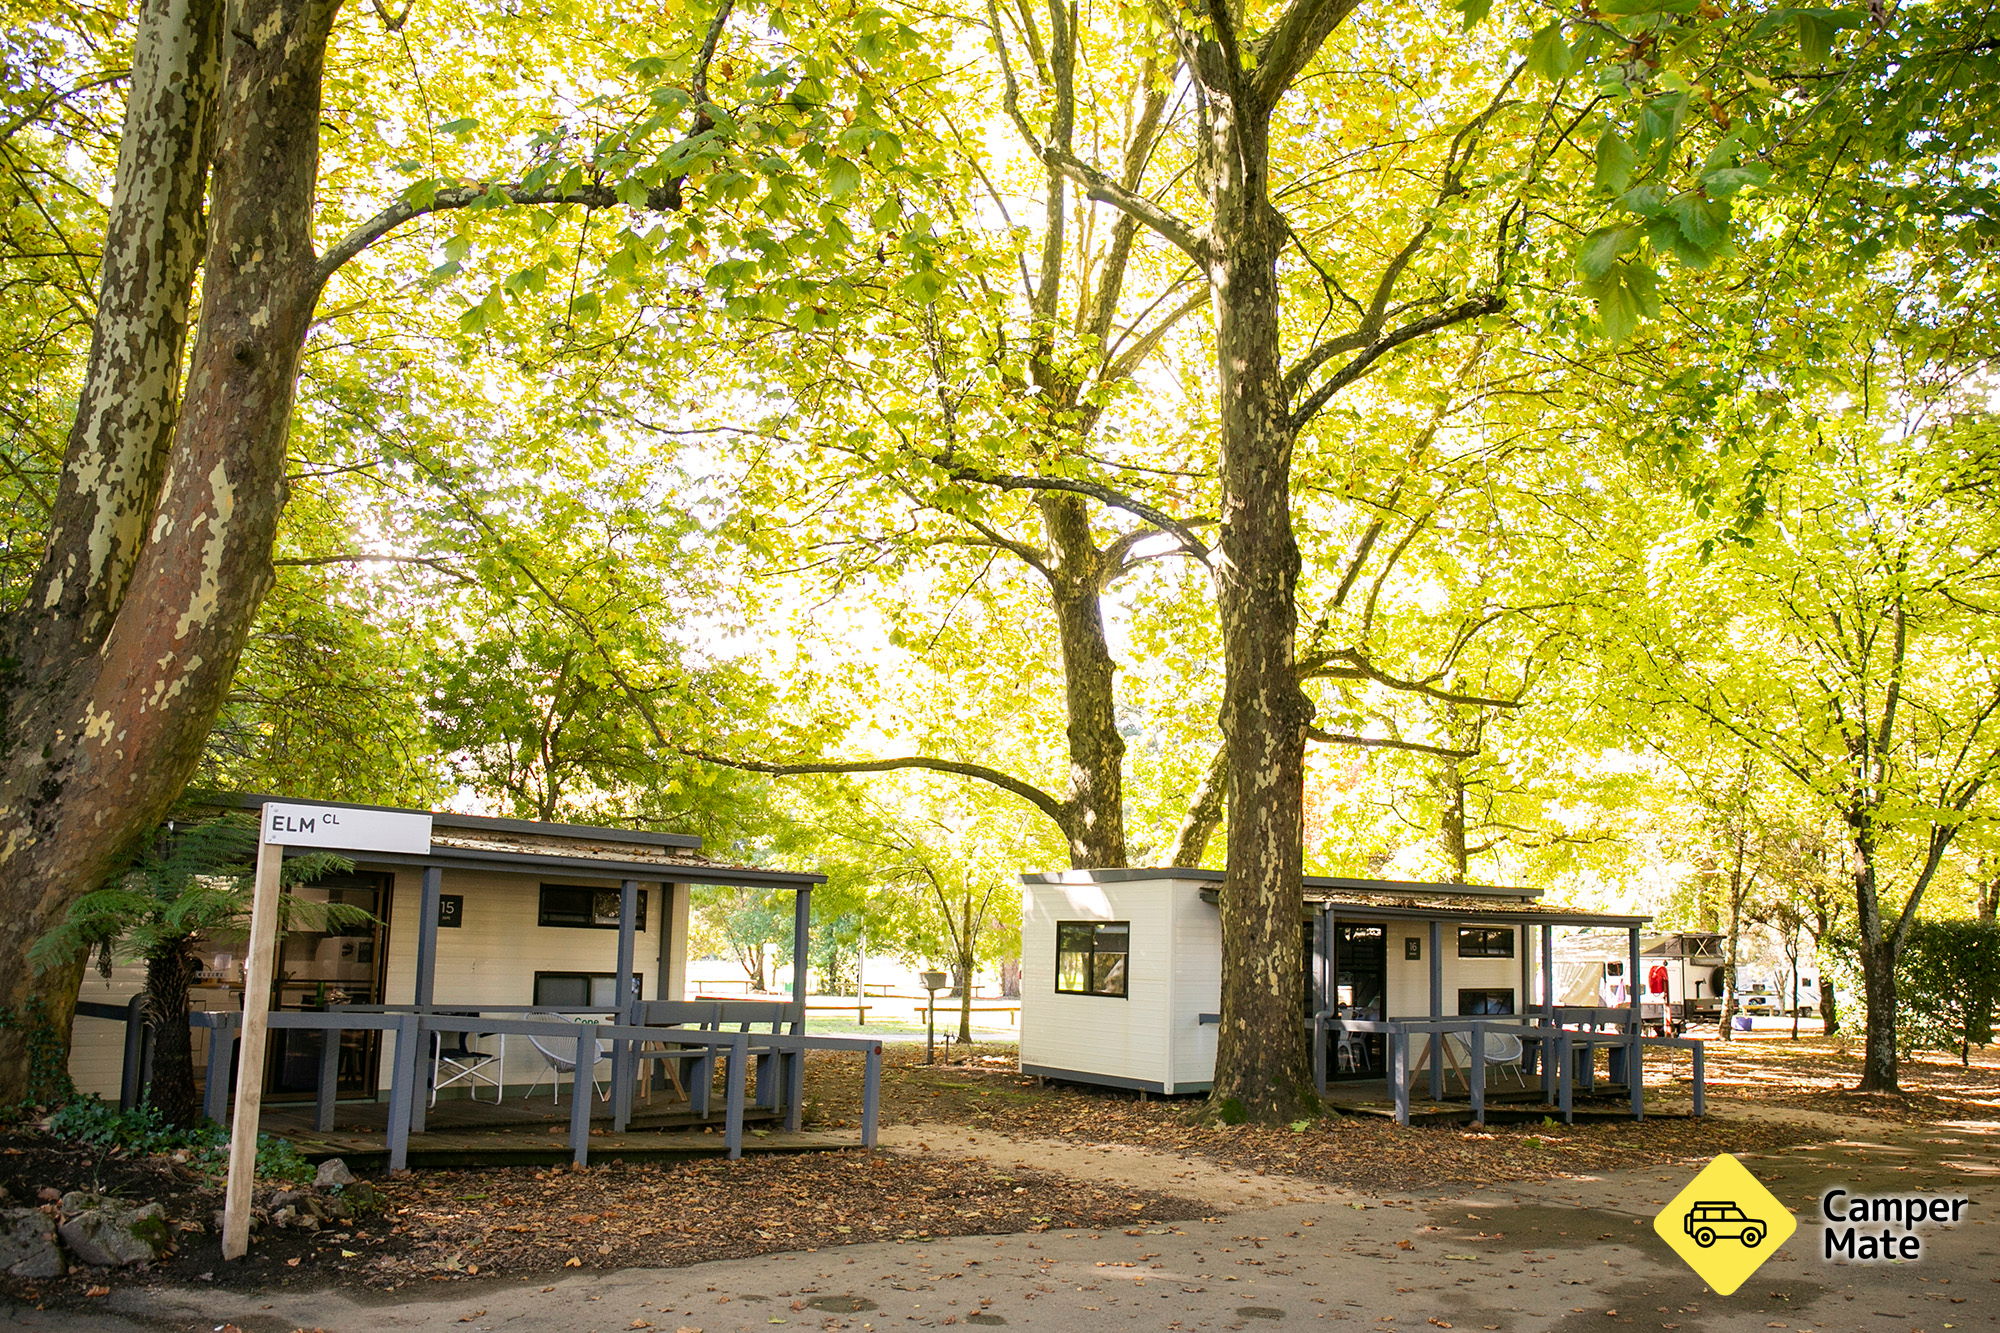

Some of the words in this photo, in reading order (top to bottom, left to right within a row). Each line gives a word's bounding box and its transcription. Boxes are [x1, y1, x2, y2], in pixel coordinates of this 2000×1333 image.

[272, 815, 315, 833] ELM
[322, 813, 340, 825] CL
[441, 901, 455, 914] 15
